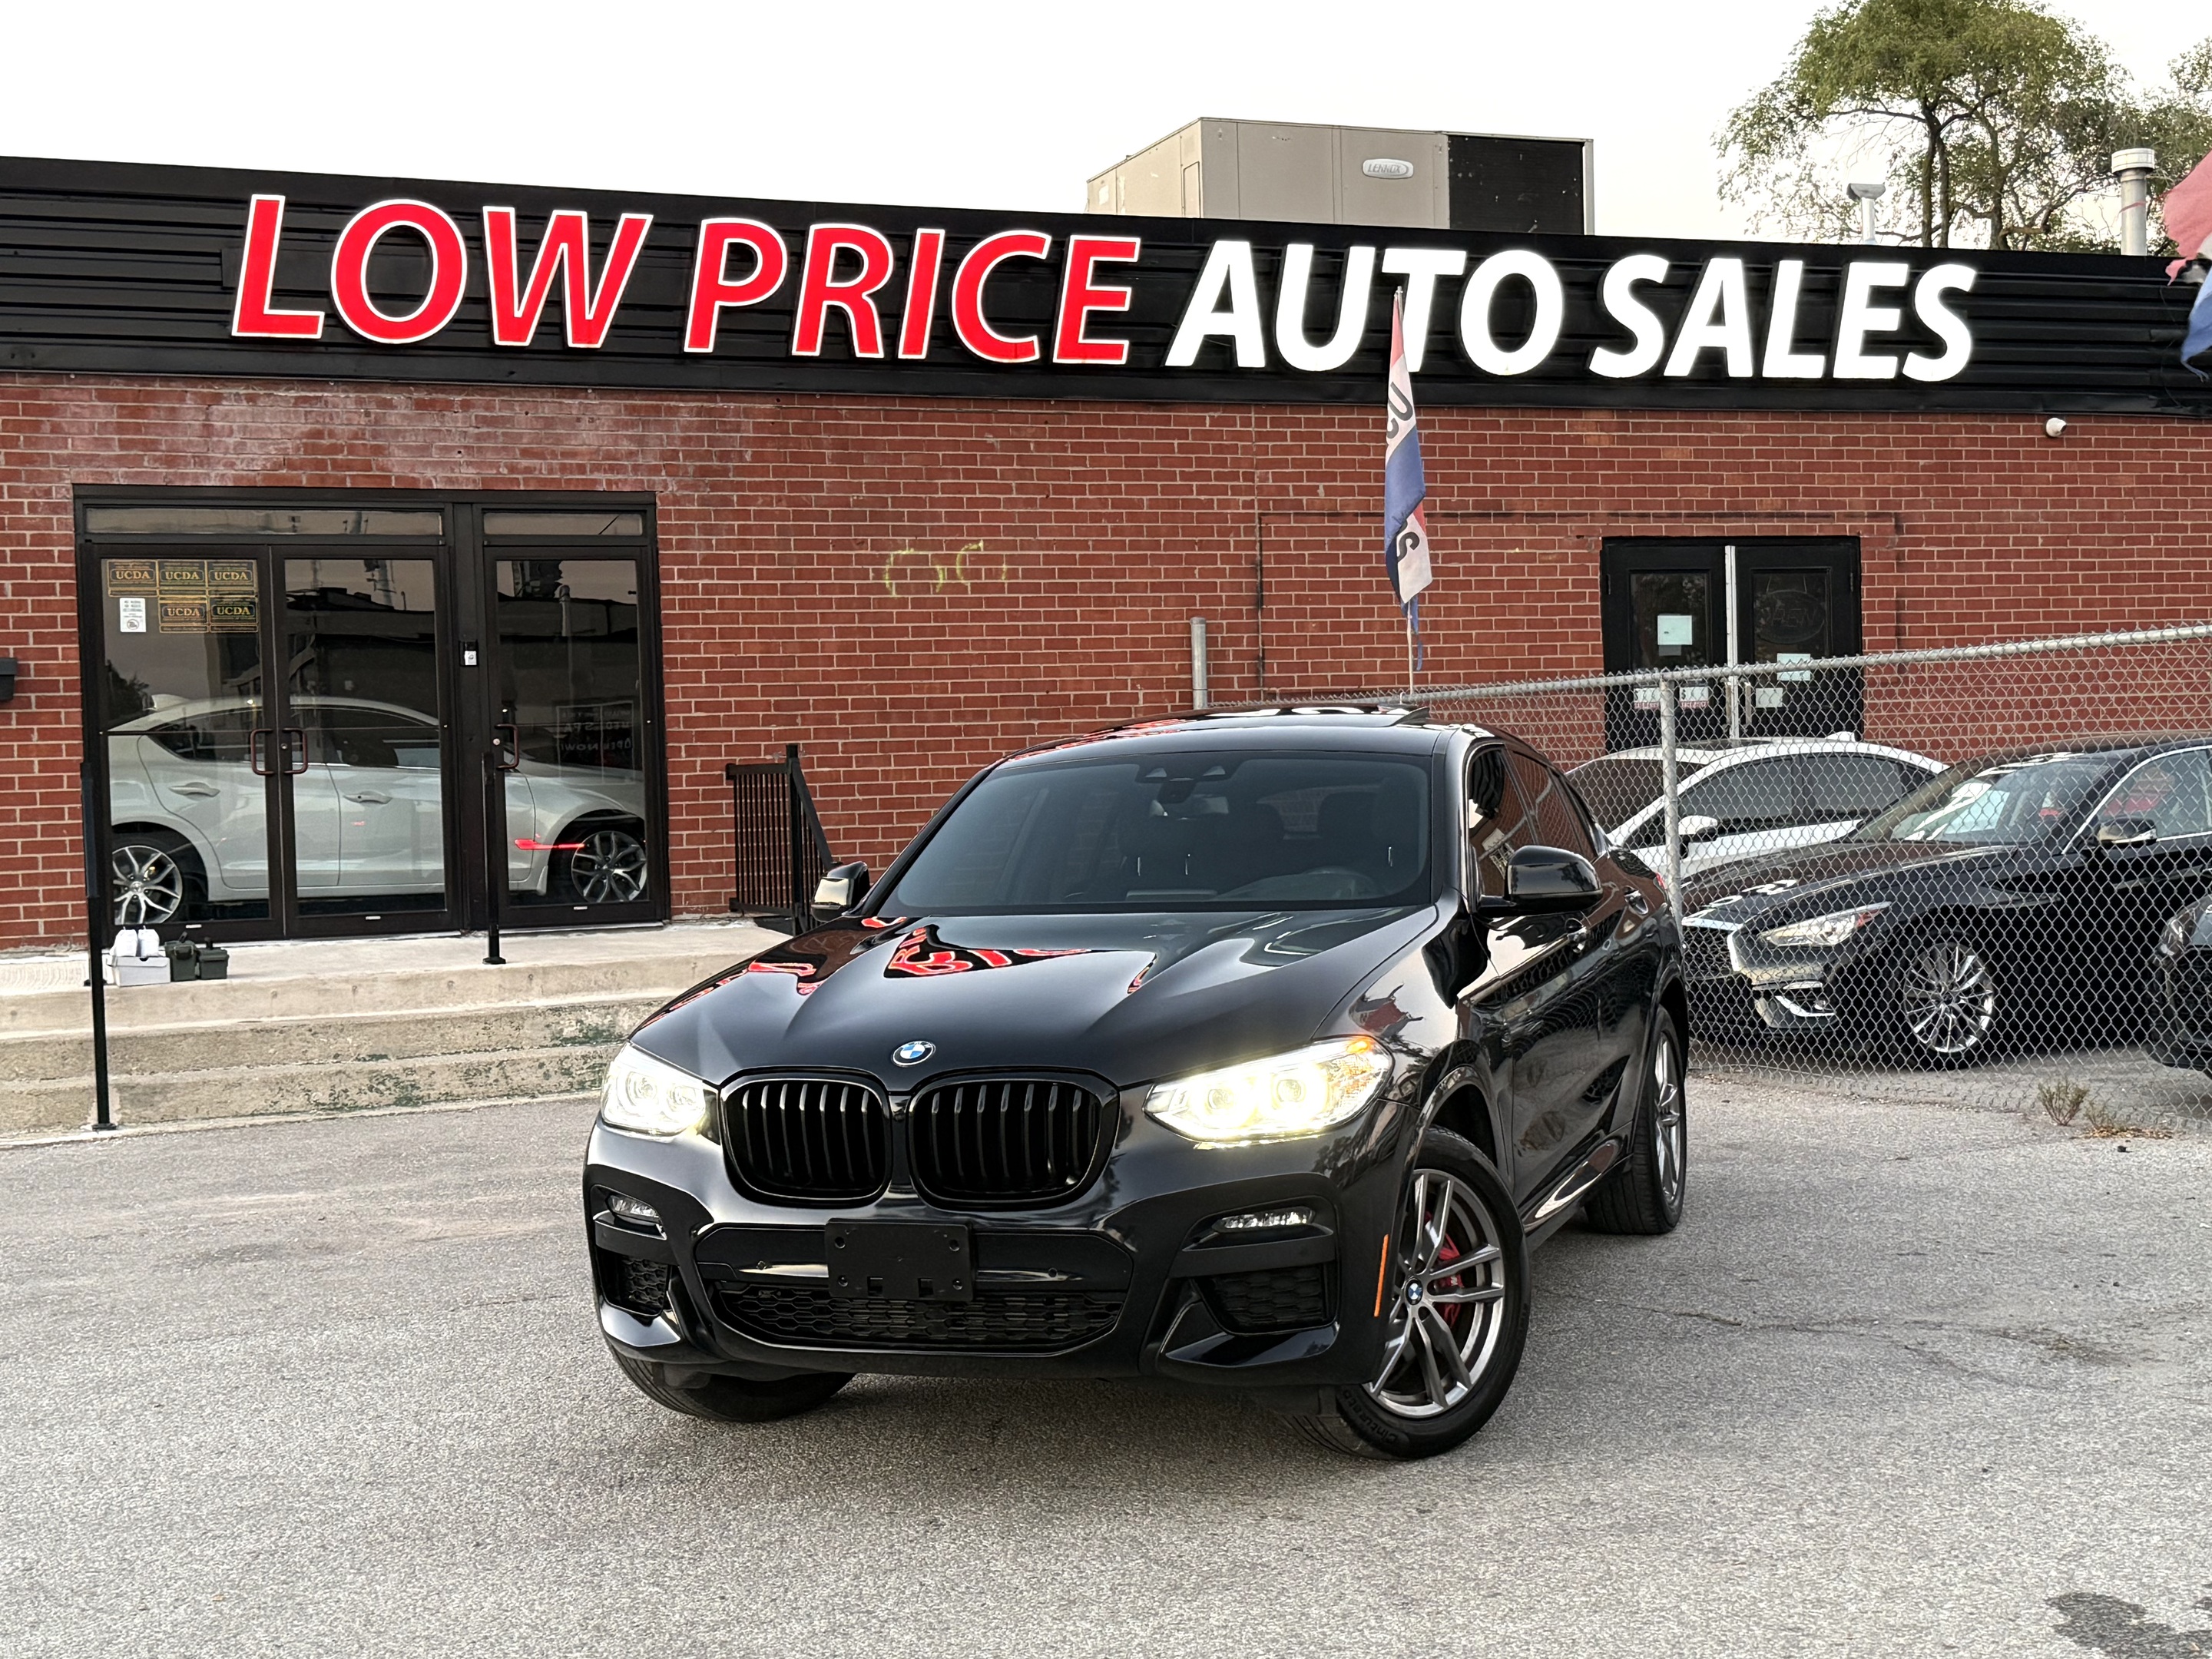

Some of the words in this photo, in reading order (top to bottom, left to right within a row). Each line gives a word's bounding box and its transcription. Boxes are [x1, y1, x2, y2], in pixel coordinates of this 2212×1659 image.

[1368, 164, 1401, 174] LENNOX
[232, 194, 654, 348] LOW
[684, 217, 1141, 365] PRICE
[1164, 240, 1564, 376] AUTO
[1589, 254, 1977, 382] SALES
[116, 571, 151, 580] UCDA
[165, 571, 200, 580] UCDA
[214, 571, 249, 581] UCDA
[167, 608, 200, 616] UCDA
[217, 607, 250, 615] UCDA
